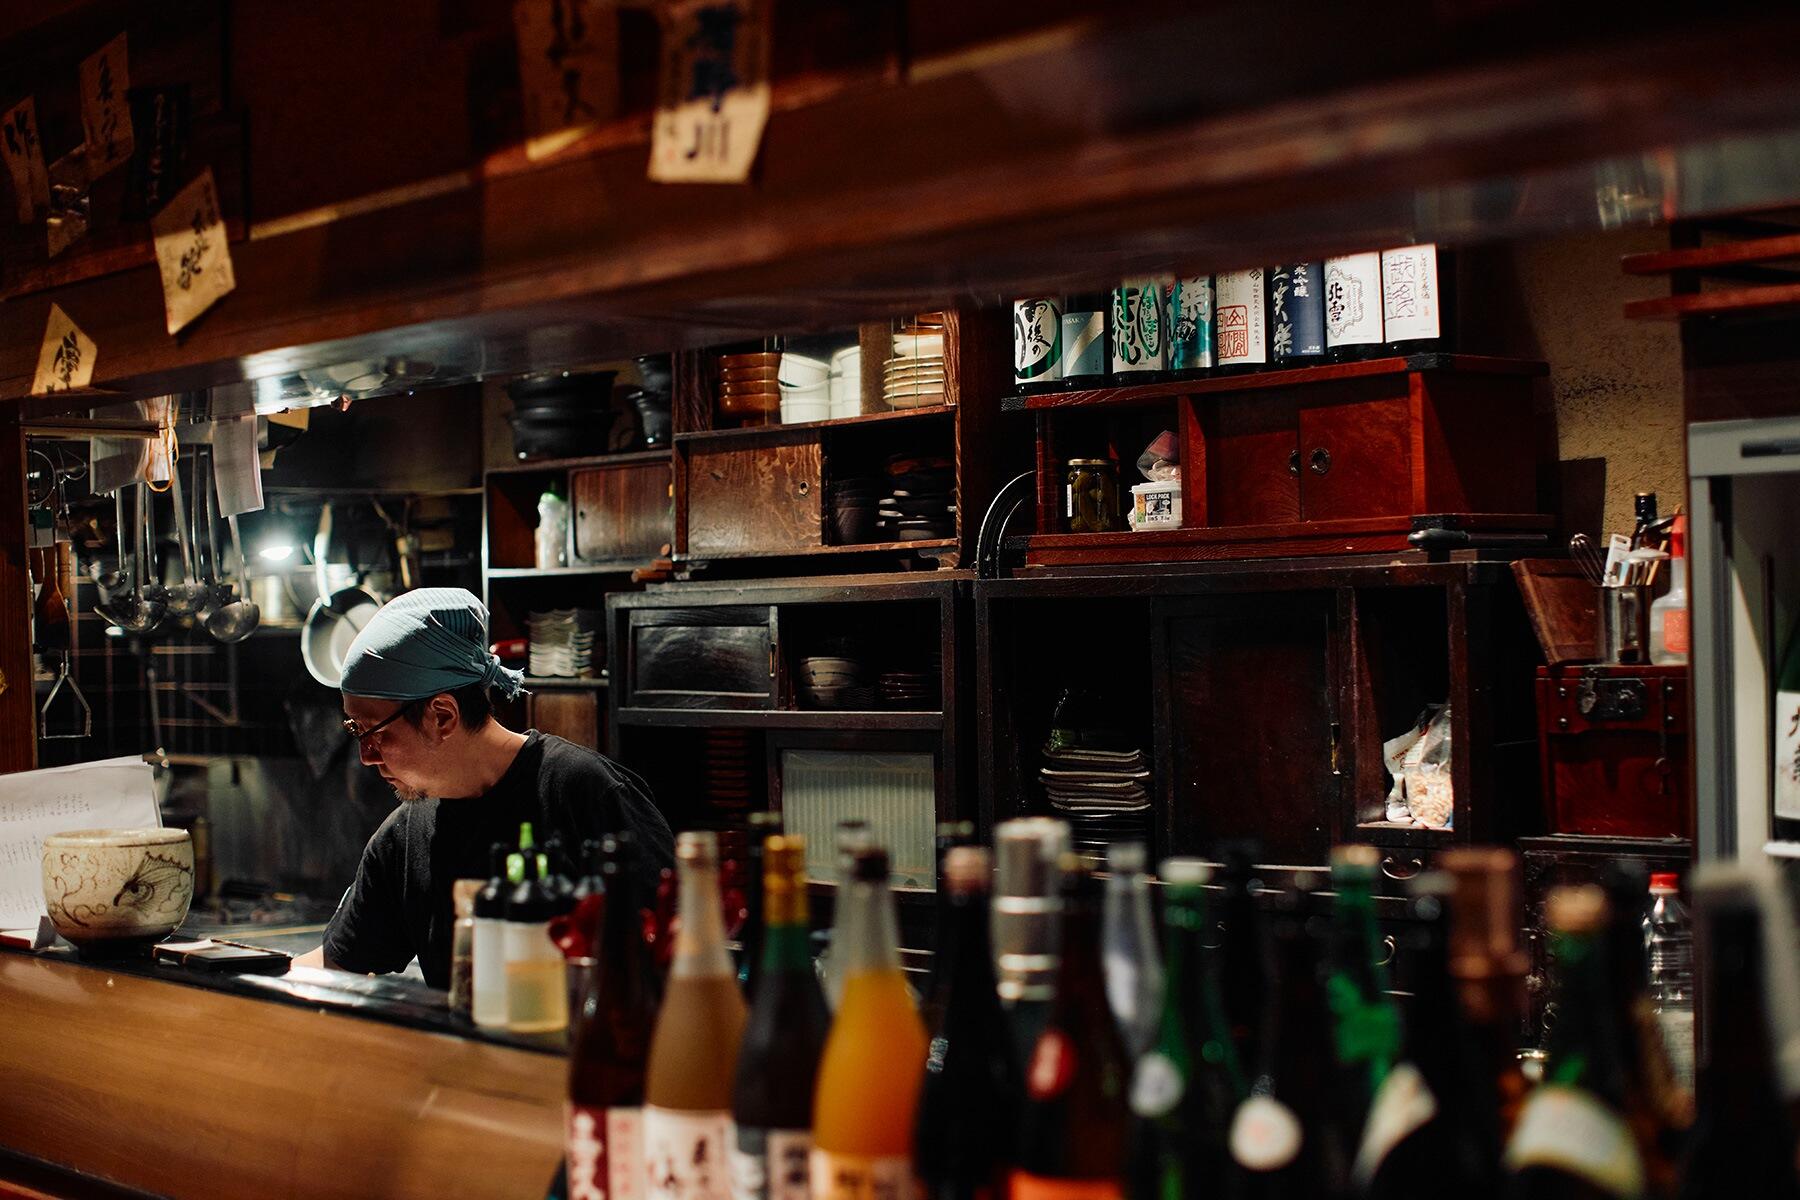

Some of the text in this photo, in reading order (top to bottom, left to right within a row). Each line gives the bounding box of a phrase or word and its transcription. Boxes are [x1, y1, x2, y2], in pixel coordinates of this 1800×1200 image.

[1293, 262, 1310, 298] 米吟醸
[1328, 281, 1346, 323] 北雪
